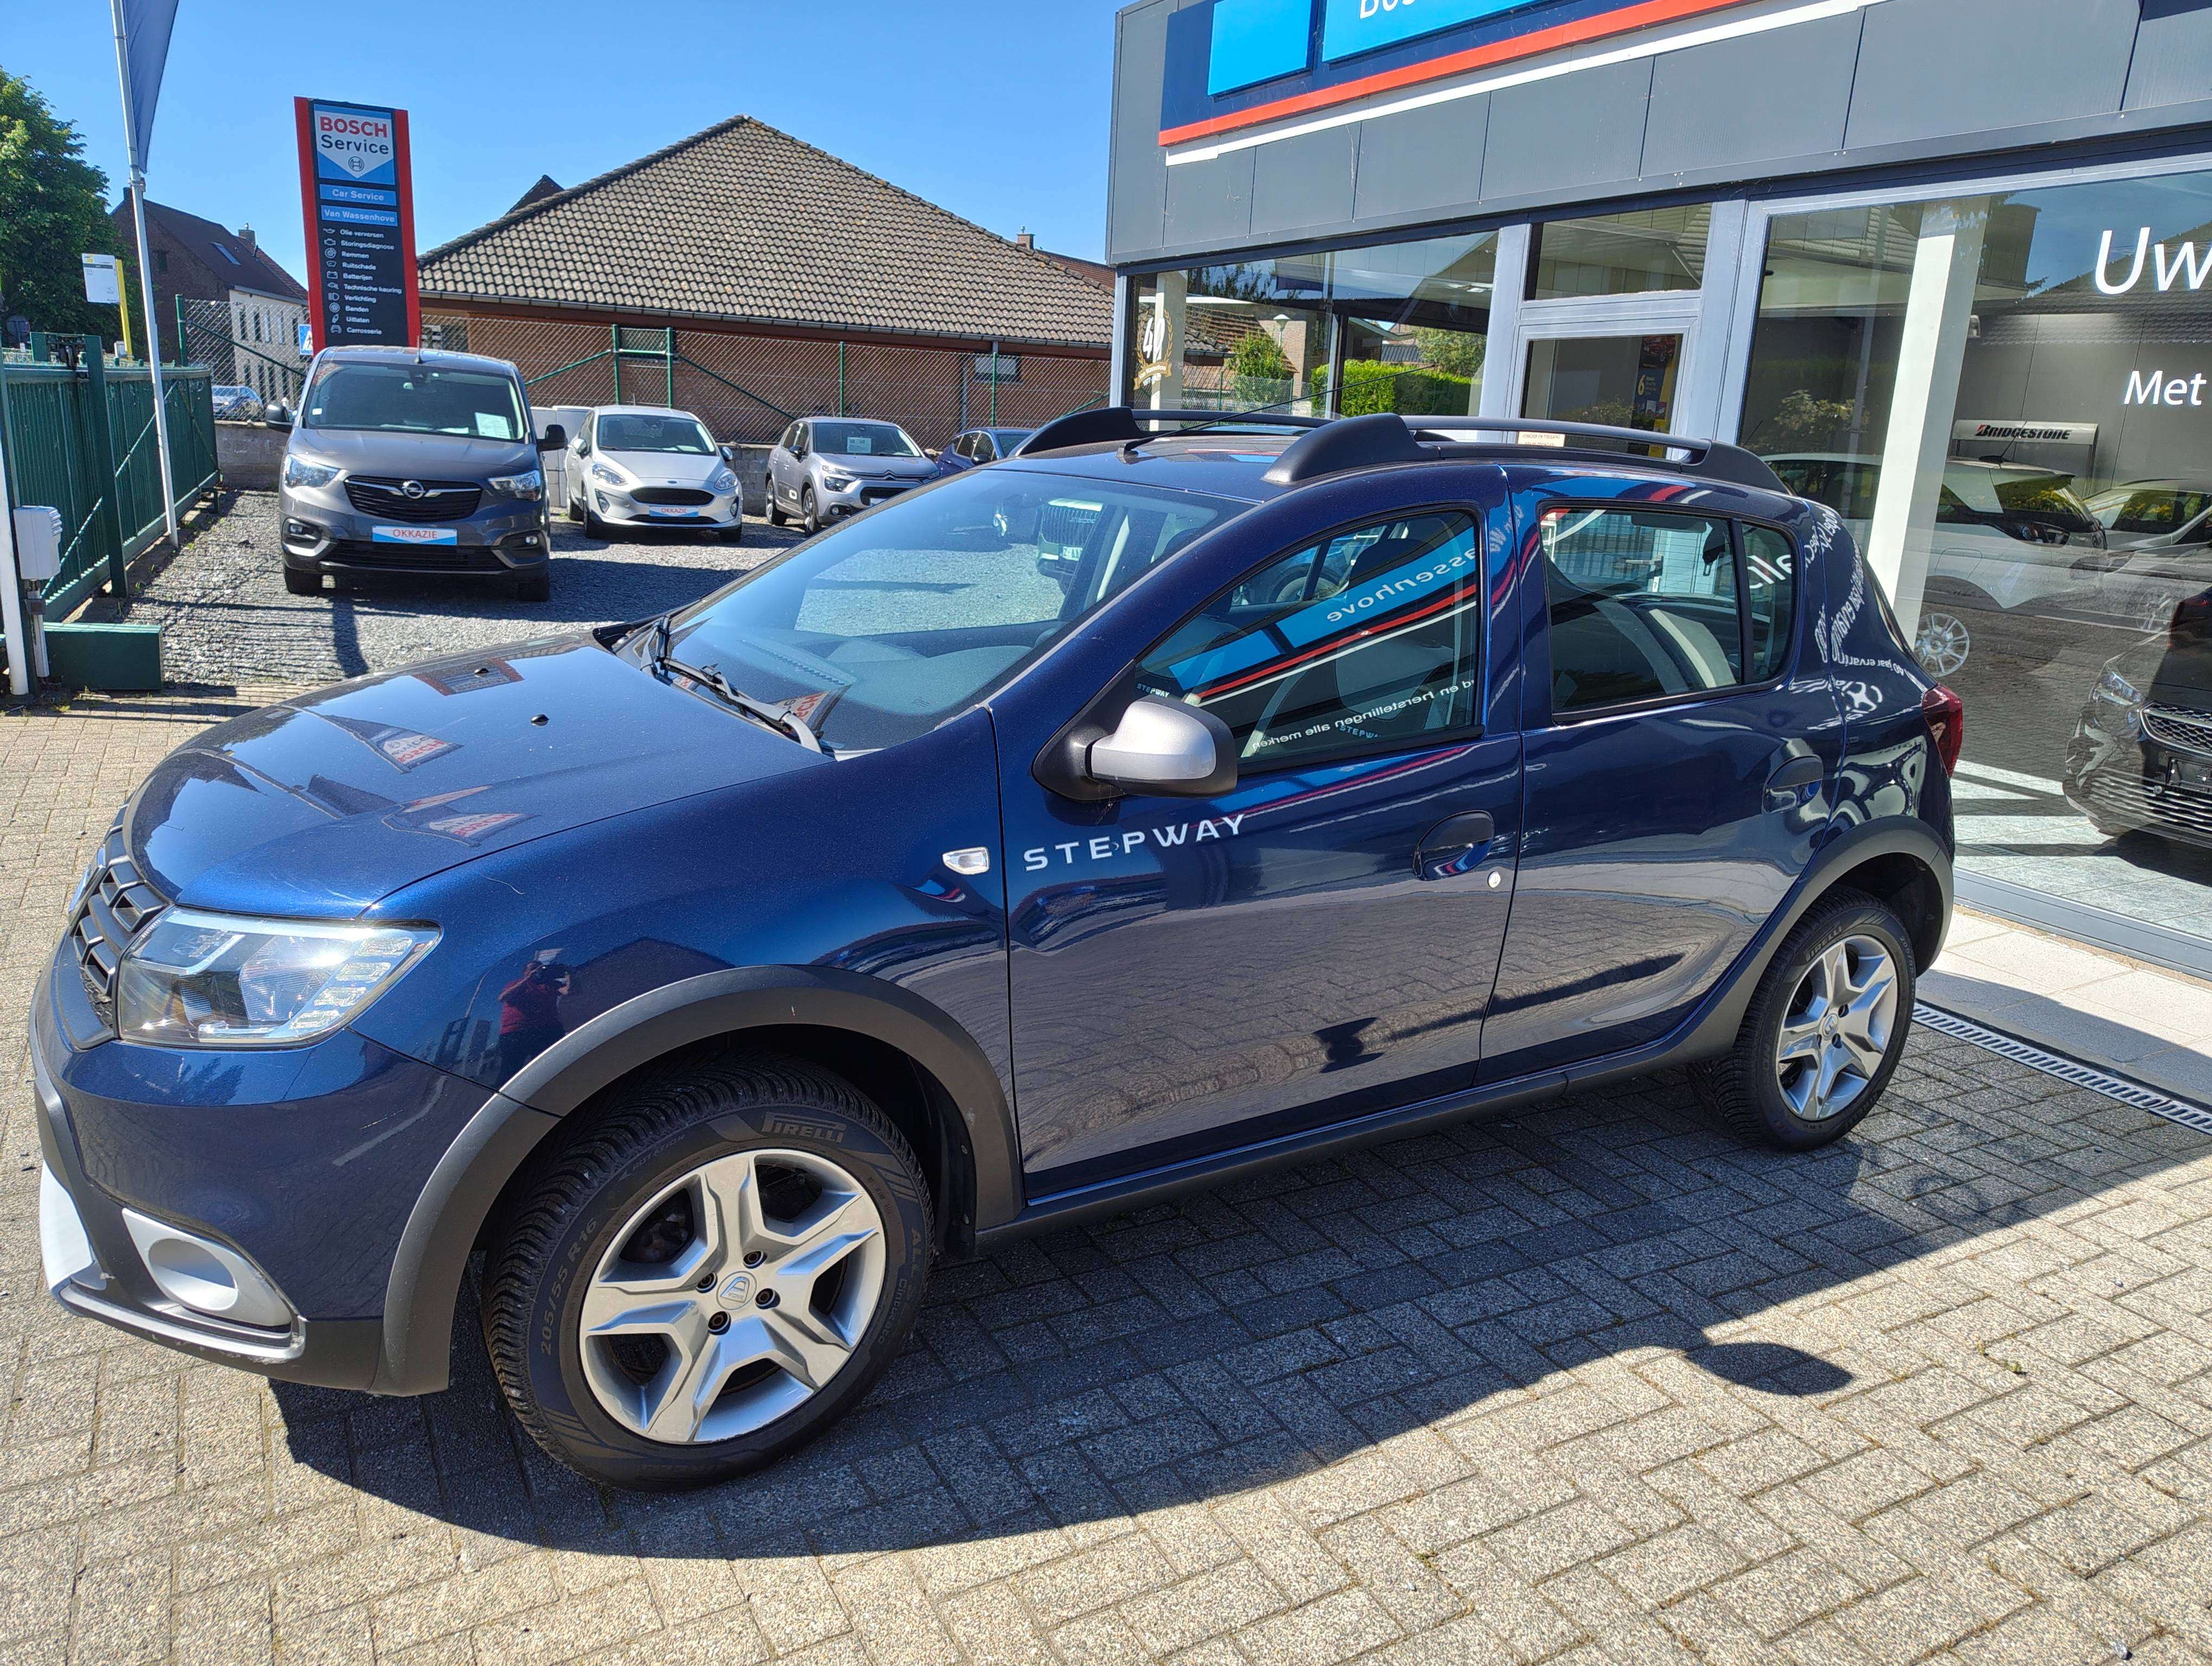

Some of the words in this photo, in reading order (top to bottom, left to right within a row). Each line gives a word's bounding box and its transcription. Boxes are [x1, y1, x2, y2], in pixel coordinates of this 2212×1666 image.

[320, 117, 387, 138] BOSCH
[321, 134, 389, 155] Service
[332, 189, 348, 198] Car
[351, 191, 384, 201] Service
[324, 209, 340, 217] Van
[342, 210, 395, 223] Wassenhove
[343, 284, 378, 292] Technische
[2124, 370, 2207, 406] Met
[1976, 425, 2073, 440] BRIDGESTONE
[393, 529, 438, 539] OKKAZIE
[1023, 814, 1244, 872] STEPWAY
[761, 1111, 847, 1143] PIRELLI
[541, 1265, 568, 1356] 205/55
[568, 1218, 596, 1263] R16
